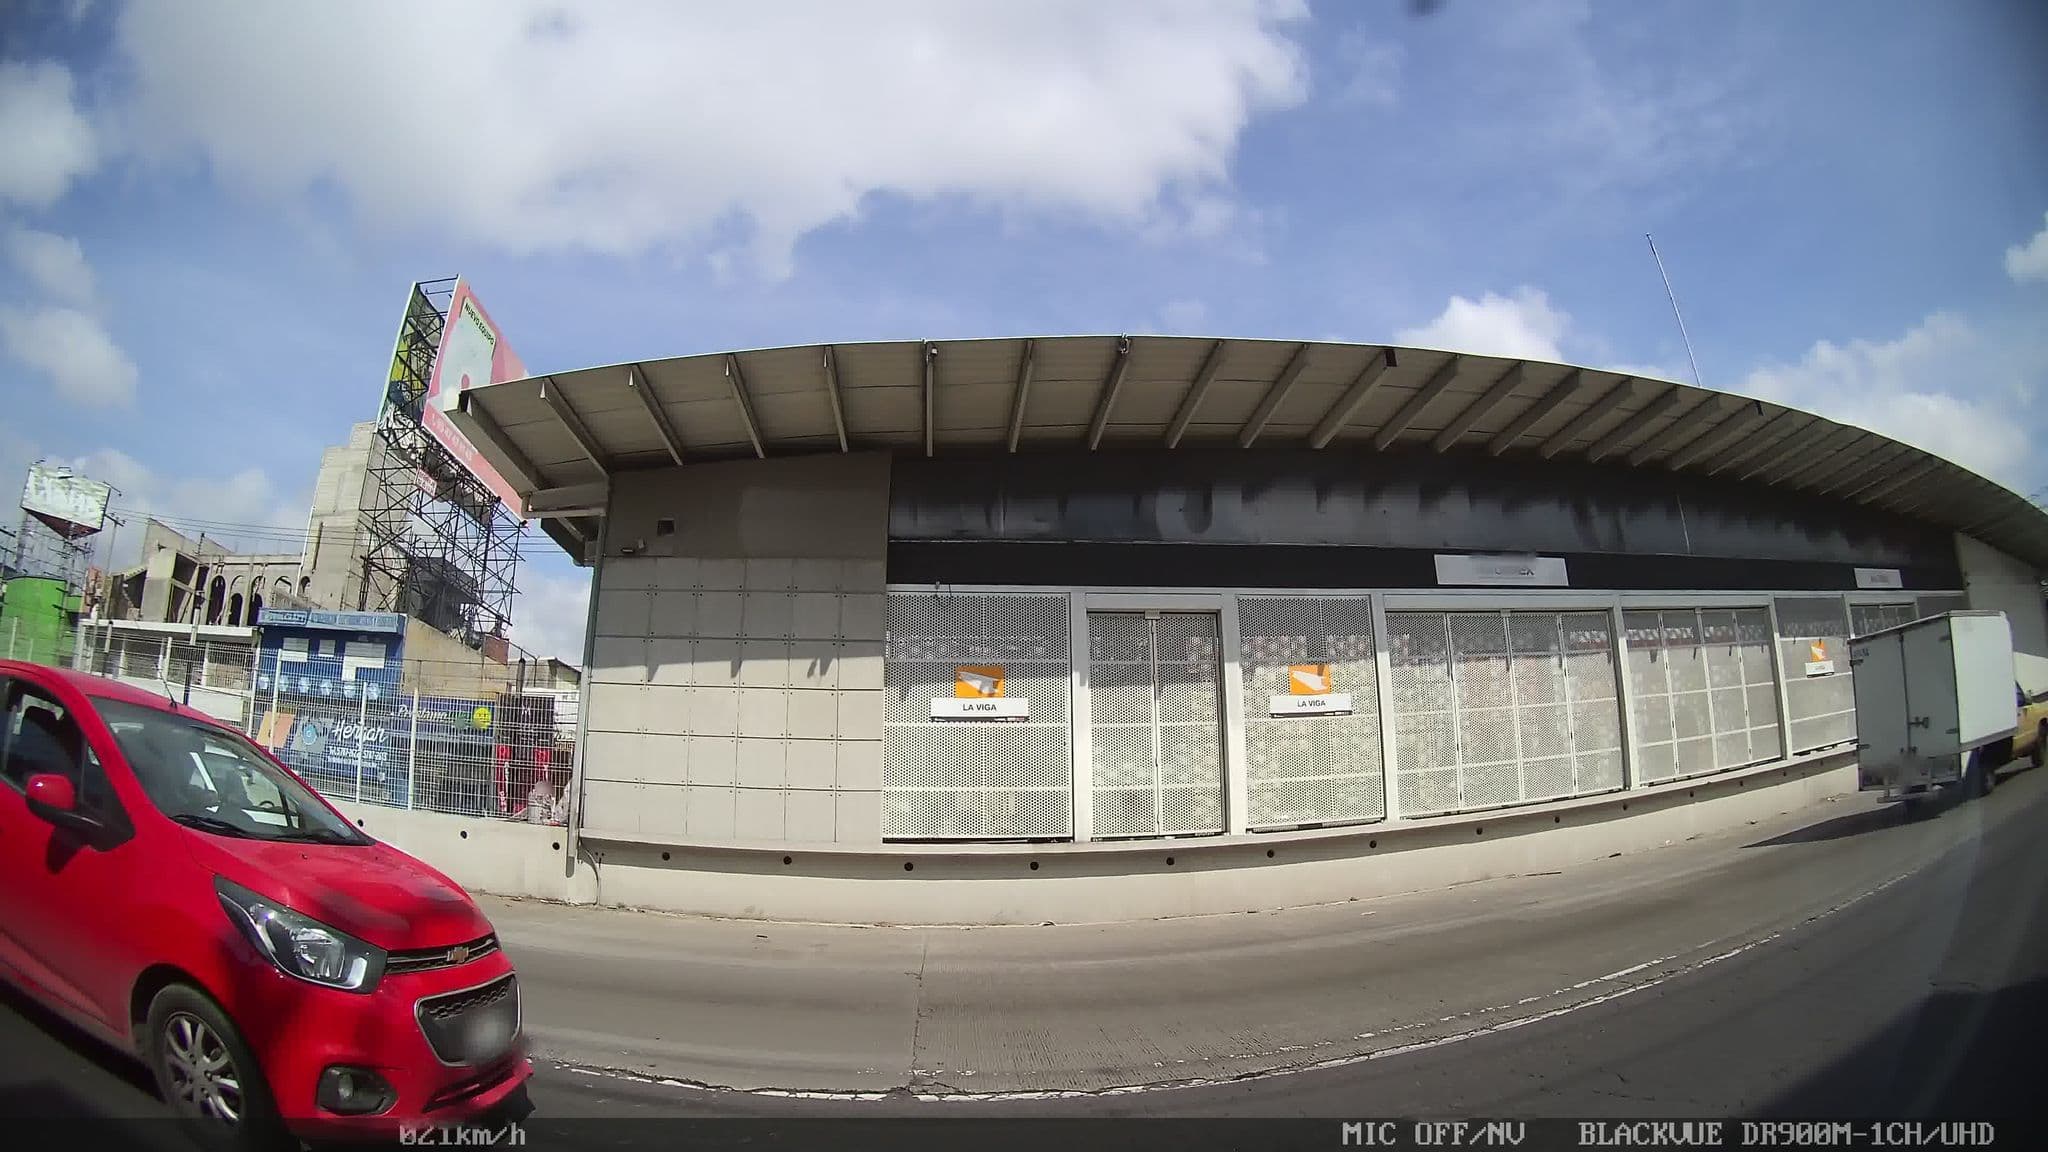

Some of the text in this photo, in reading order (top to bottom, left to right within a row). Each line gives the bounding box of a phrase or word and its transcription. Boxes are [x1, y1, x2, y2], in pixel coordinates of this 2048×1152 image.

[465, 303, 495, 345] NUEVO EQUIPO
[962, 703, 997, 712] LA VIGA
[1297, 699, 1326, 708] LA VIGA
